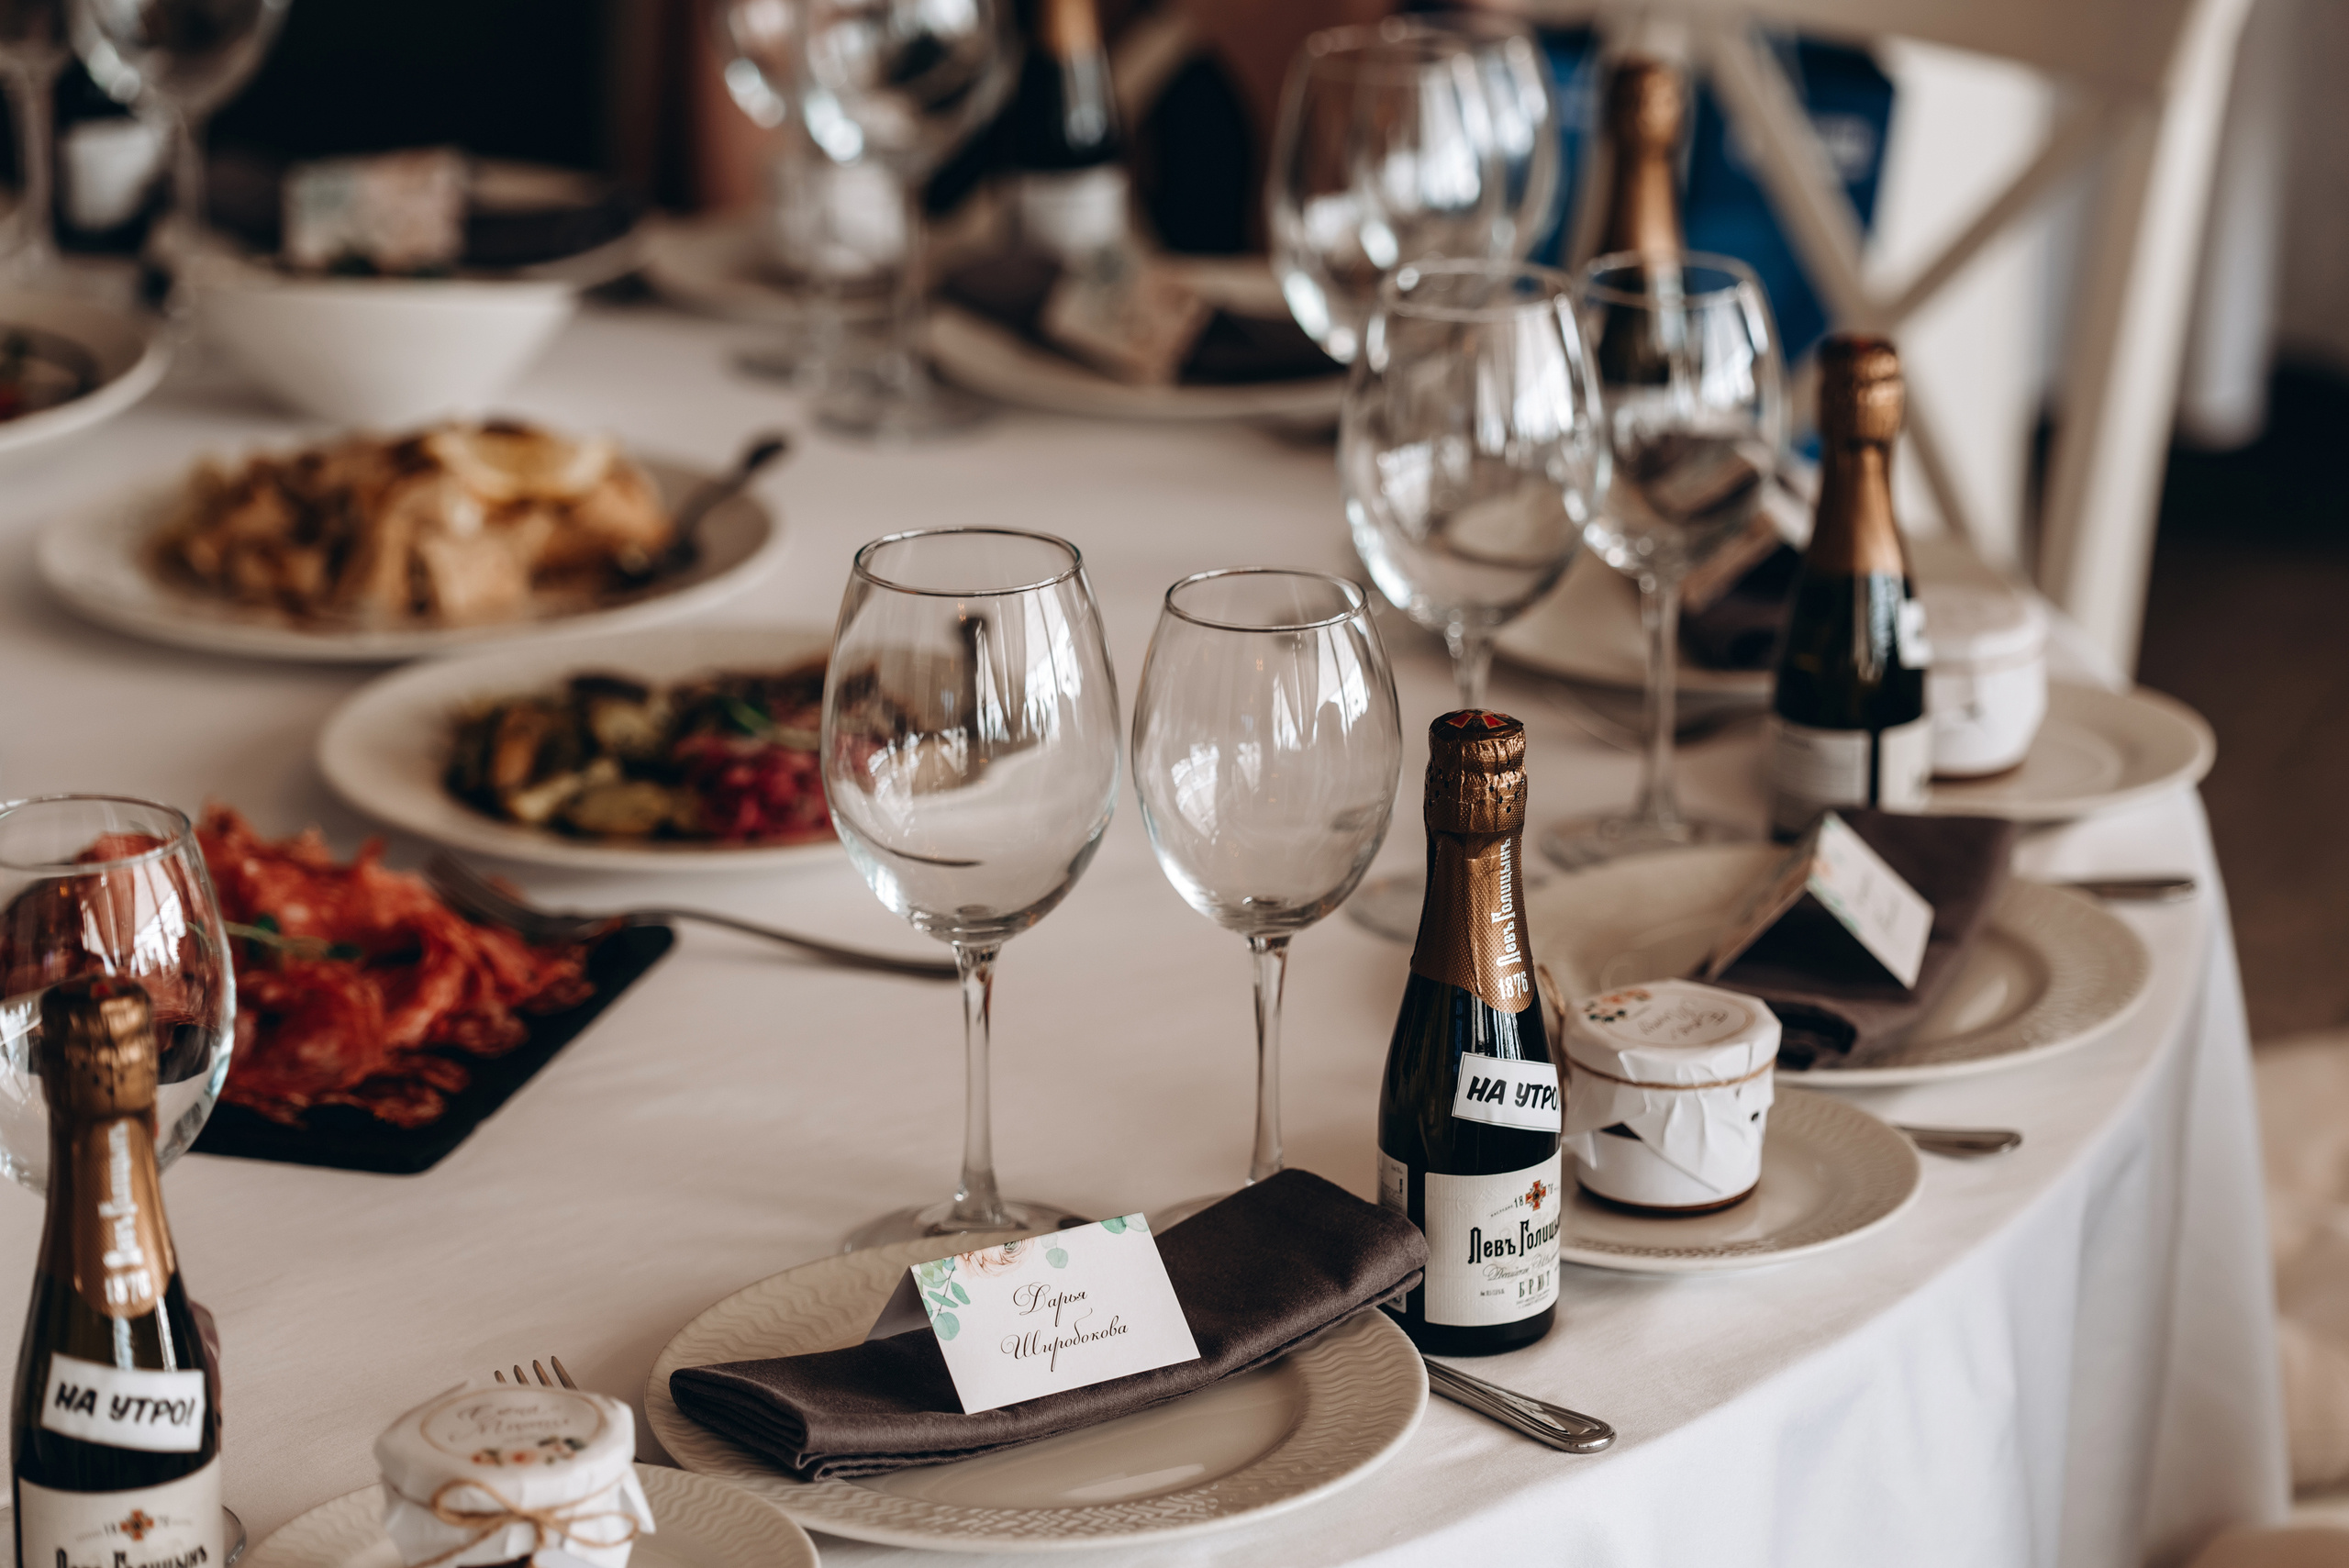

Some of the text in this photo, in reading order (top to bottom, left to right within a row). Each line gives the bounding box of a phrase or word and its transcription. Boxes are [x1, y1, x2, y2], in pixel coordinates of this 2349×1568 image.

[1491, 838, 1521, 967] Левъ Голицынъ
[1497, 971, 1529, 1000] 1876
[1466, 1075, 1507, 1105] НА
[1468, 1227, 1516, 1264] Левъ
[1519, 1270, 1550, 1298] БРЮТ
[1013, 1282, 1088, 1328] Дарья
[1000, 1307, 1130, 1373] Широбокова
[54, 1382, 196, 1427] НА УТРО!
